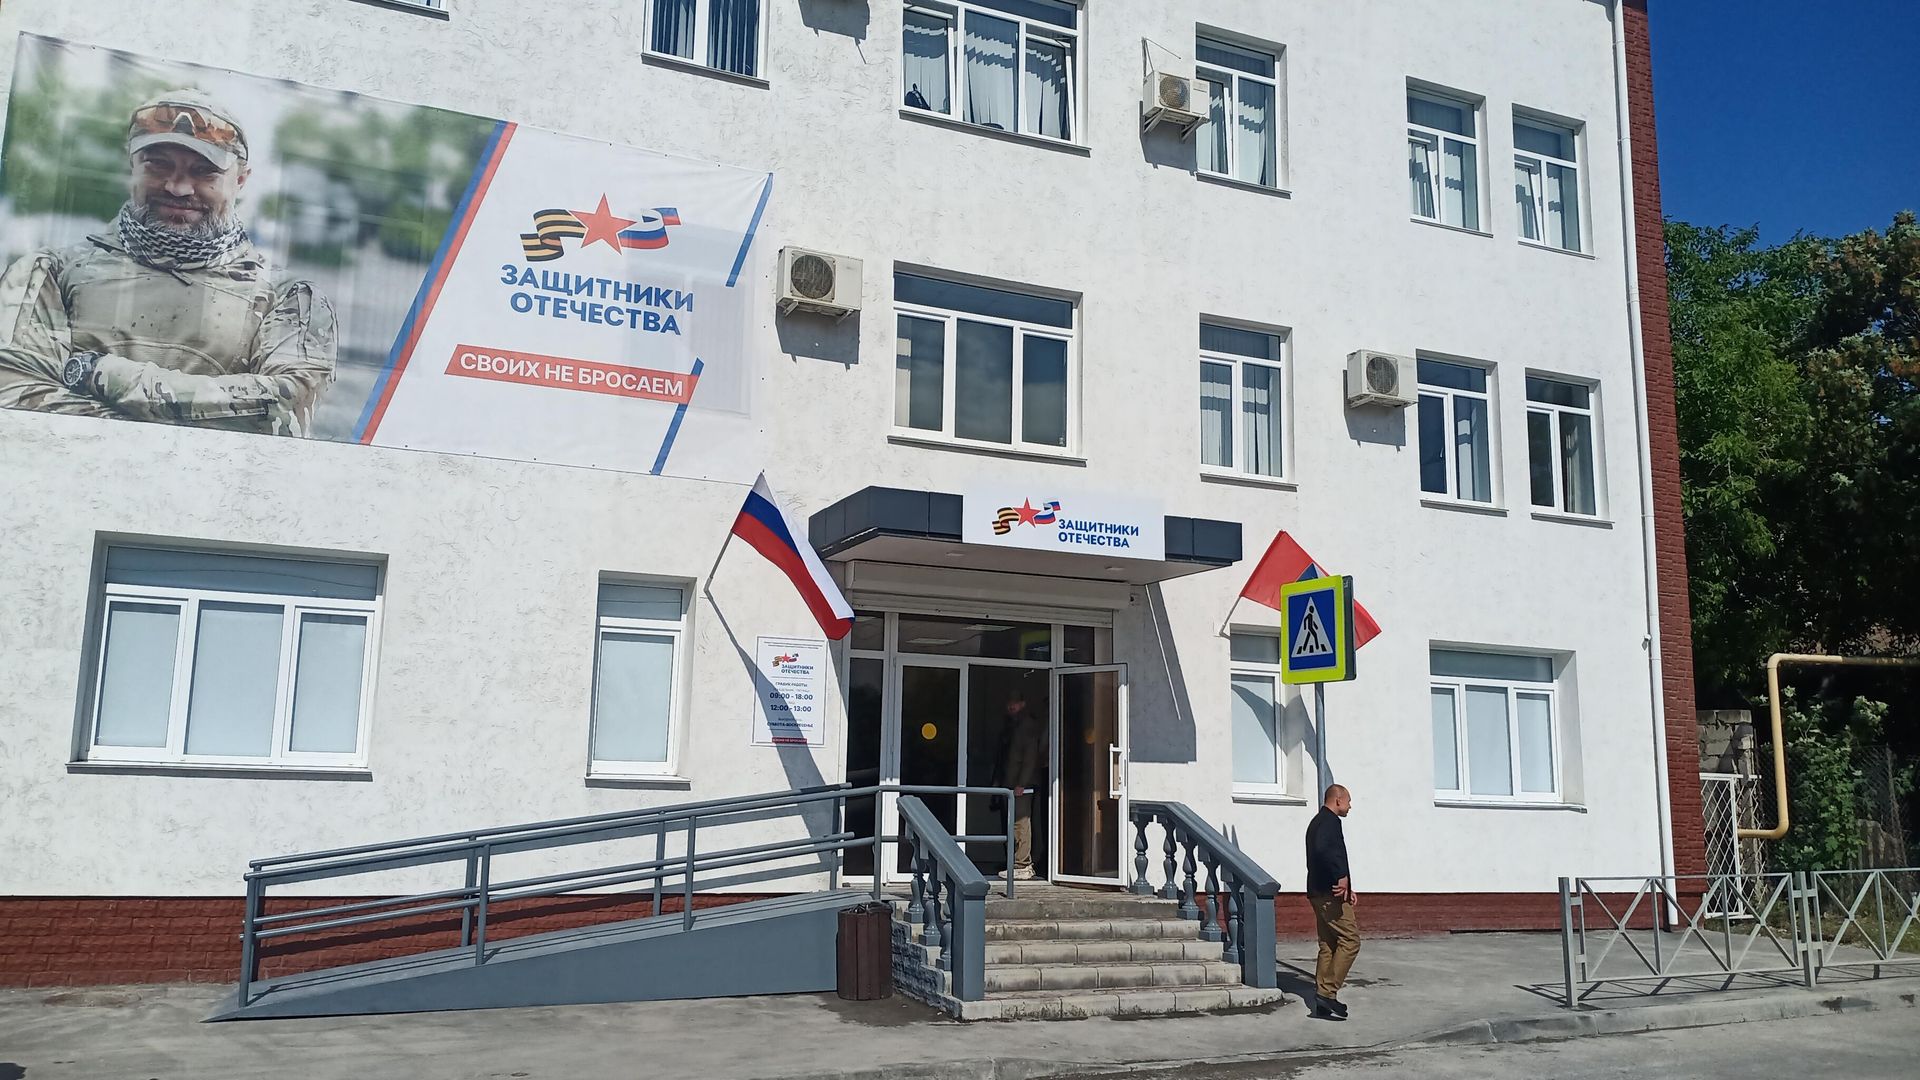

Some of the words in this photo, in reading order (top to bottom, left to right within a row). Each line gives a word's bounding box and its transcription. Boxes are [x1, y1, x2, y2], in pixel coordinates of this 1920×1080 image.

[500, 264, 694, 312] ЗАЩИТНИКИ
[510, 292, 682, 335] ОТЕЧЕСТВА
[459, 352, 540, 379] СВОИХ
[545, 363, 573, 383] НЕ
[578, 368, 683, 396] БРОСАЕМ
[1058, 518, 1139, 537] ЗАЩИТНИКИ
[1058, 532, 1130, 548] ОТЕЧЕСТВА
